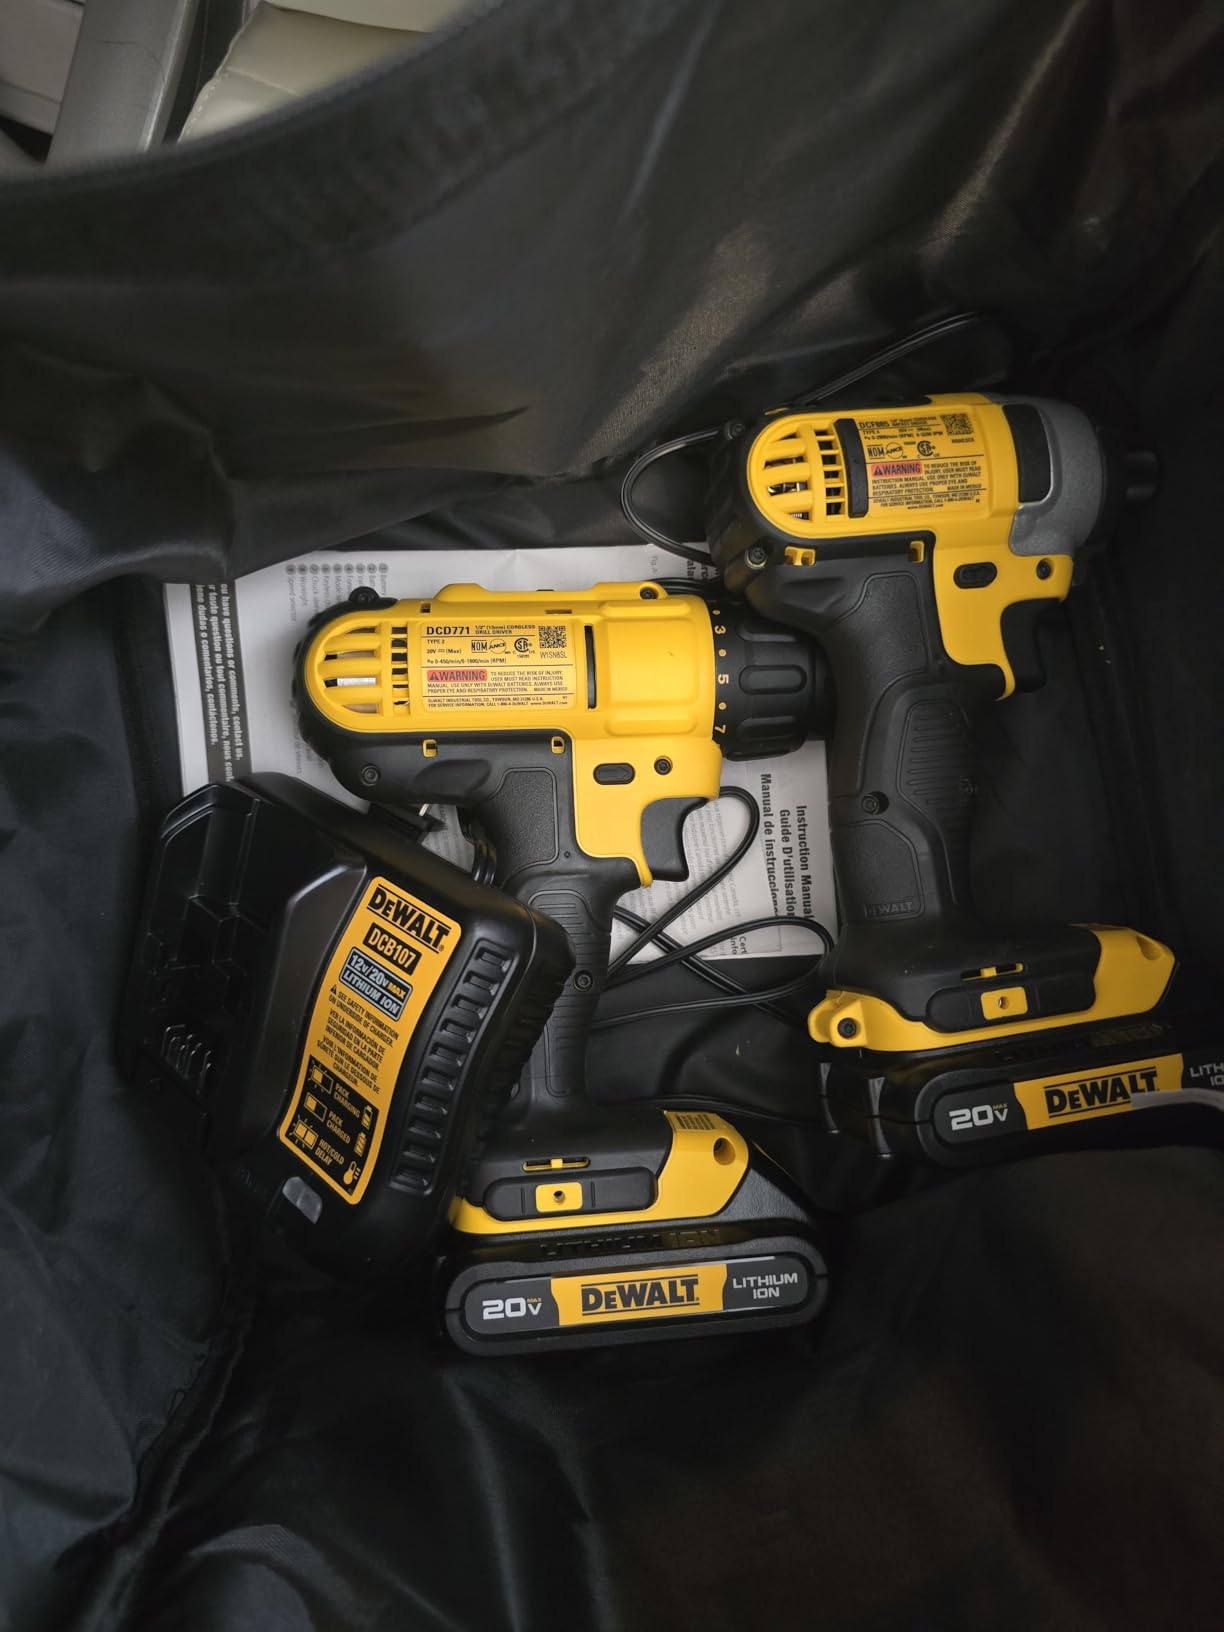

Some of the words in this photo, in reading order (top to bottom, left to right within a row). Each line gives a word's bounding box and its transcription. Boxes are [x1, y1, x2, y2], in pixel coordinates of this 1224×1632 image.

[868, 447, 885, 456] NOM
[883, 464, 920, 475] WARNING
[209, 592, 219, 614] toute
[222, 596, 230, 616] have
[198, 605, 208, 630] dudas
[714, 626, 726, 634] 3
[210, 616, 222, 651] question
[222, 618, 234, 658] questions
[426, 626, 470, 635] DCD771
[215, 653, 222, 664] ou
[472, 642, 487, 651] NOM
[201, 640, 214, 692] comentarios,
[216, 666, 226, 682] tout
[228, 660, 235, 668] or
[440, 671, 485, 680] WARNING
[718, 674, 729, 684] 5
[228, 670, 240, 714] comments,
[207, 694, 218, 746] contáctenos.
[218, 684, 230, 738] commentaire,
[233, 716, 244, 746] contact
[715, 725, 726, 734] 7
[235, 748, 243, 760] us.
[761, 774, 774, 817] Manual
[764, 821, 774, 835] de
[780, 809, 792, 842] Guide
[796, 806, 810, 870] Instruction
[801, 875, 814, 918] Manual
[368, 886, 450, 950] DEWALT
[368, 927, 416, 968] DCB107
[343, 970, 382, 1000] LITHIUM
[381, 997, 400, 1014] ION
[387, 982, 406, 999] MAX
[329, 994, 336, 1004] ON
[336, 999, 363, 1024] UNDERSIDE
[363, 1020, 370, 1029] OF
[338, 992, 347, 1000] SEE
[347, 998, 365, 1015] SAFETY
[364, 1010, 399, 1040] INFORMATION
[326, 1024, 346, 1045] INFERIOR
[346, 1041, 353, 1050] DE
[328, 1016, 354, 1040] SEGURIDAD
[354, 1036, 360, 1046] EN
[361, 1041, 367, 1050] LA
[367, 1046, 384, 1064] PARTE
[330, 1008, 339, 1019] VER
[339, 1014, 345, 1024] LA
[378, 1045, 386, 1054] DE
[323, 1035, 334, 1048] VOIR
[370, 1072, 378, 1083] DE
[334, 1054, 344, 1065] SUR
[344, 1061, 350, 1070] LE
[350, 1066, 373, 1088] DESSOUS
[373, 1084, 380, 1095] DE
[336, 1082, 350, 1099] PACK
[333, 1091, 361, 1118] CHARGING
[328, 1111, 344, 1127] PACK
[949, 1105, 1008, 1130] 20V
[326, 1119, 351, 1144] CHARGED
[315, 1147, 332, 1166] DELAY
[319, 1138, 344, 1165] HOT/COLD
[733, 1273, 797, 1288] LITHIUM
[753, 1287, 779, 1299] ION
[482, 1297, 542, 1320] 20V
[582, 1279, 698, 1312] DEWALT
